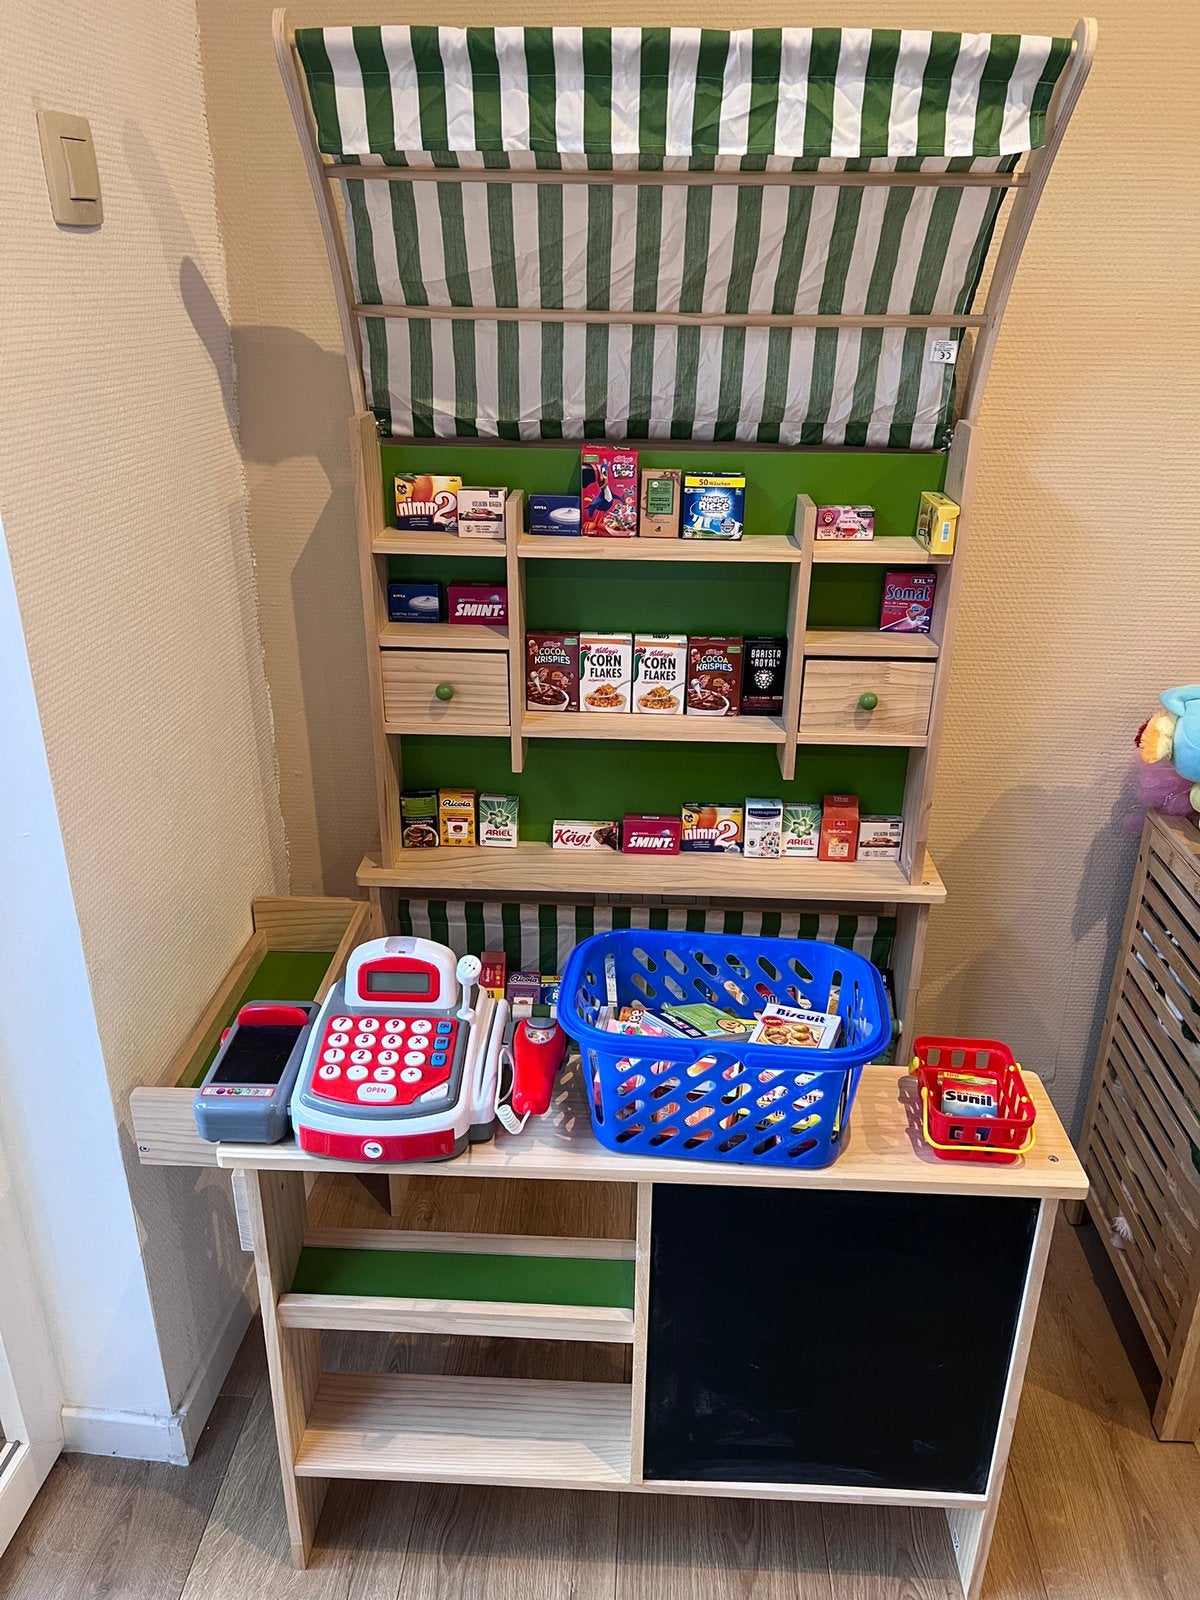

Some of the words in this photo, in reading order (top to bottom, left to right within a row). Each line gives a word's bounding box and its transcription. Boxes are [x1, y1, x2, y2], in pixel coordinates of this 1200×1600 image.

[612, 464, 635, 472] FROOT
[613, 470, 634, 478] LOOPS
[698, 501, 730, 511] Riese
[885, 584, 930, 601] Somat
[539, 647, 566, 656] COCOA
[751, 650, 781, 658] BARISTA
[535, 655, 571, 664] KRISPIES
[590, 654, 621, 667] CORN
[644, 657, 676, 669] CORN
[701, 655, 728, 664] COCOA
[754, 659, 776, 667] ROYAL
[696, 663, 733, 672] KRISPIES
[590, 668, 622, 678] FLAKES
[644, 670, 676, 680] FLAKES
[554, 829, 592, 846] Kägi
[510, 974, 539, 983] Ricola
[776, 1008, 826, 1023] Biscuit
[339, 1018, 347, 1027] 7
[365, 1020, 373, 1028] 8
[392, 1020, 400, 1029] 9
[335, 1034, 342, 1042] 4
[361, 1034, 369, 1043] 5
[388, 1036, 396, 1044] 6
[333, 1050, 337, 1058] 1
[357, 1051, 365, 1059] 2
[385, 1052, 392, 1060] 3
[326, 1066, 334, 1075] 0
[945, 1090, 992, 1106] Sunil
